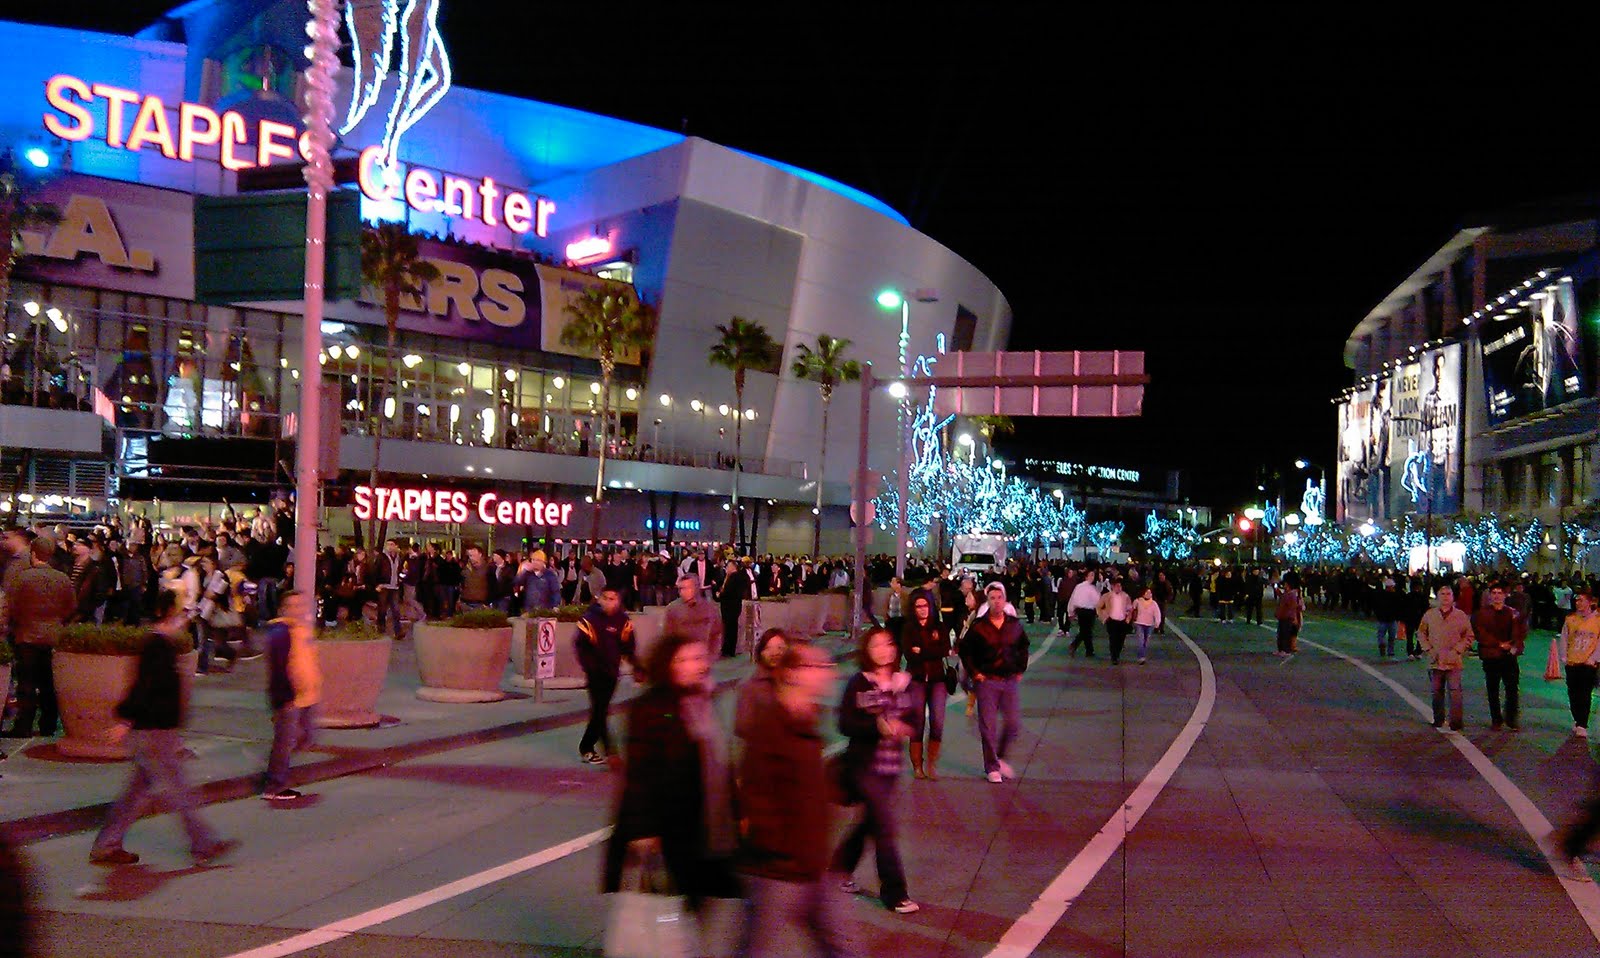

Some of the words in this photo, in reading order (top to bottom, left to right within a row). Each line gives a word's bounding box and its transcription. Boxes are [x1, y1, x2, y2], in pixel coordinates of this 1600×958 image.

[358, 146, 556, 238] Center
[1116, 468, 1140, 482] CENTER
[353, 485, 469, 523] STAPLES
[478, 492, 573, 527] Center
